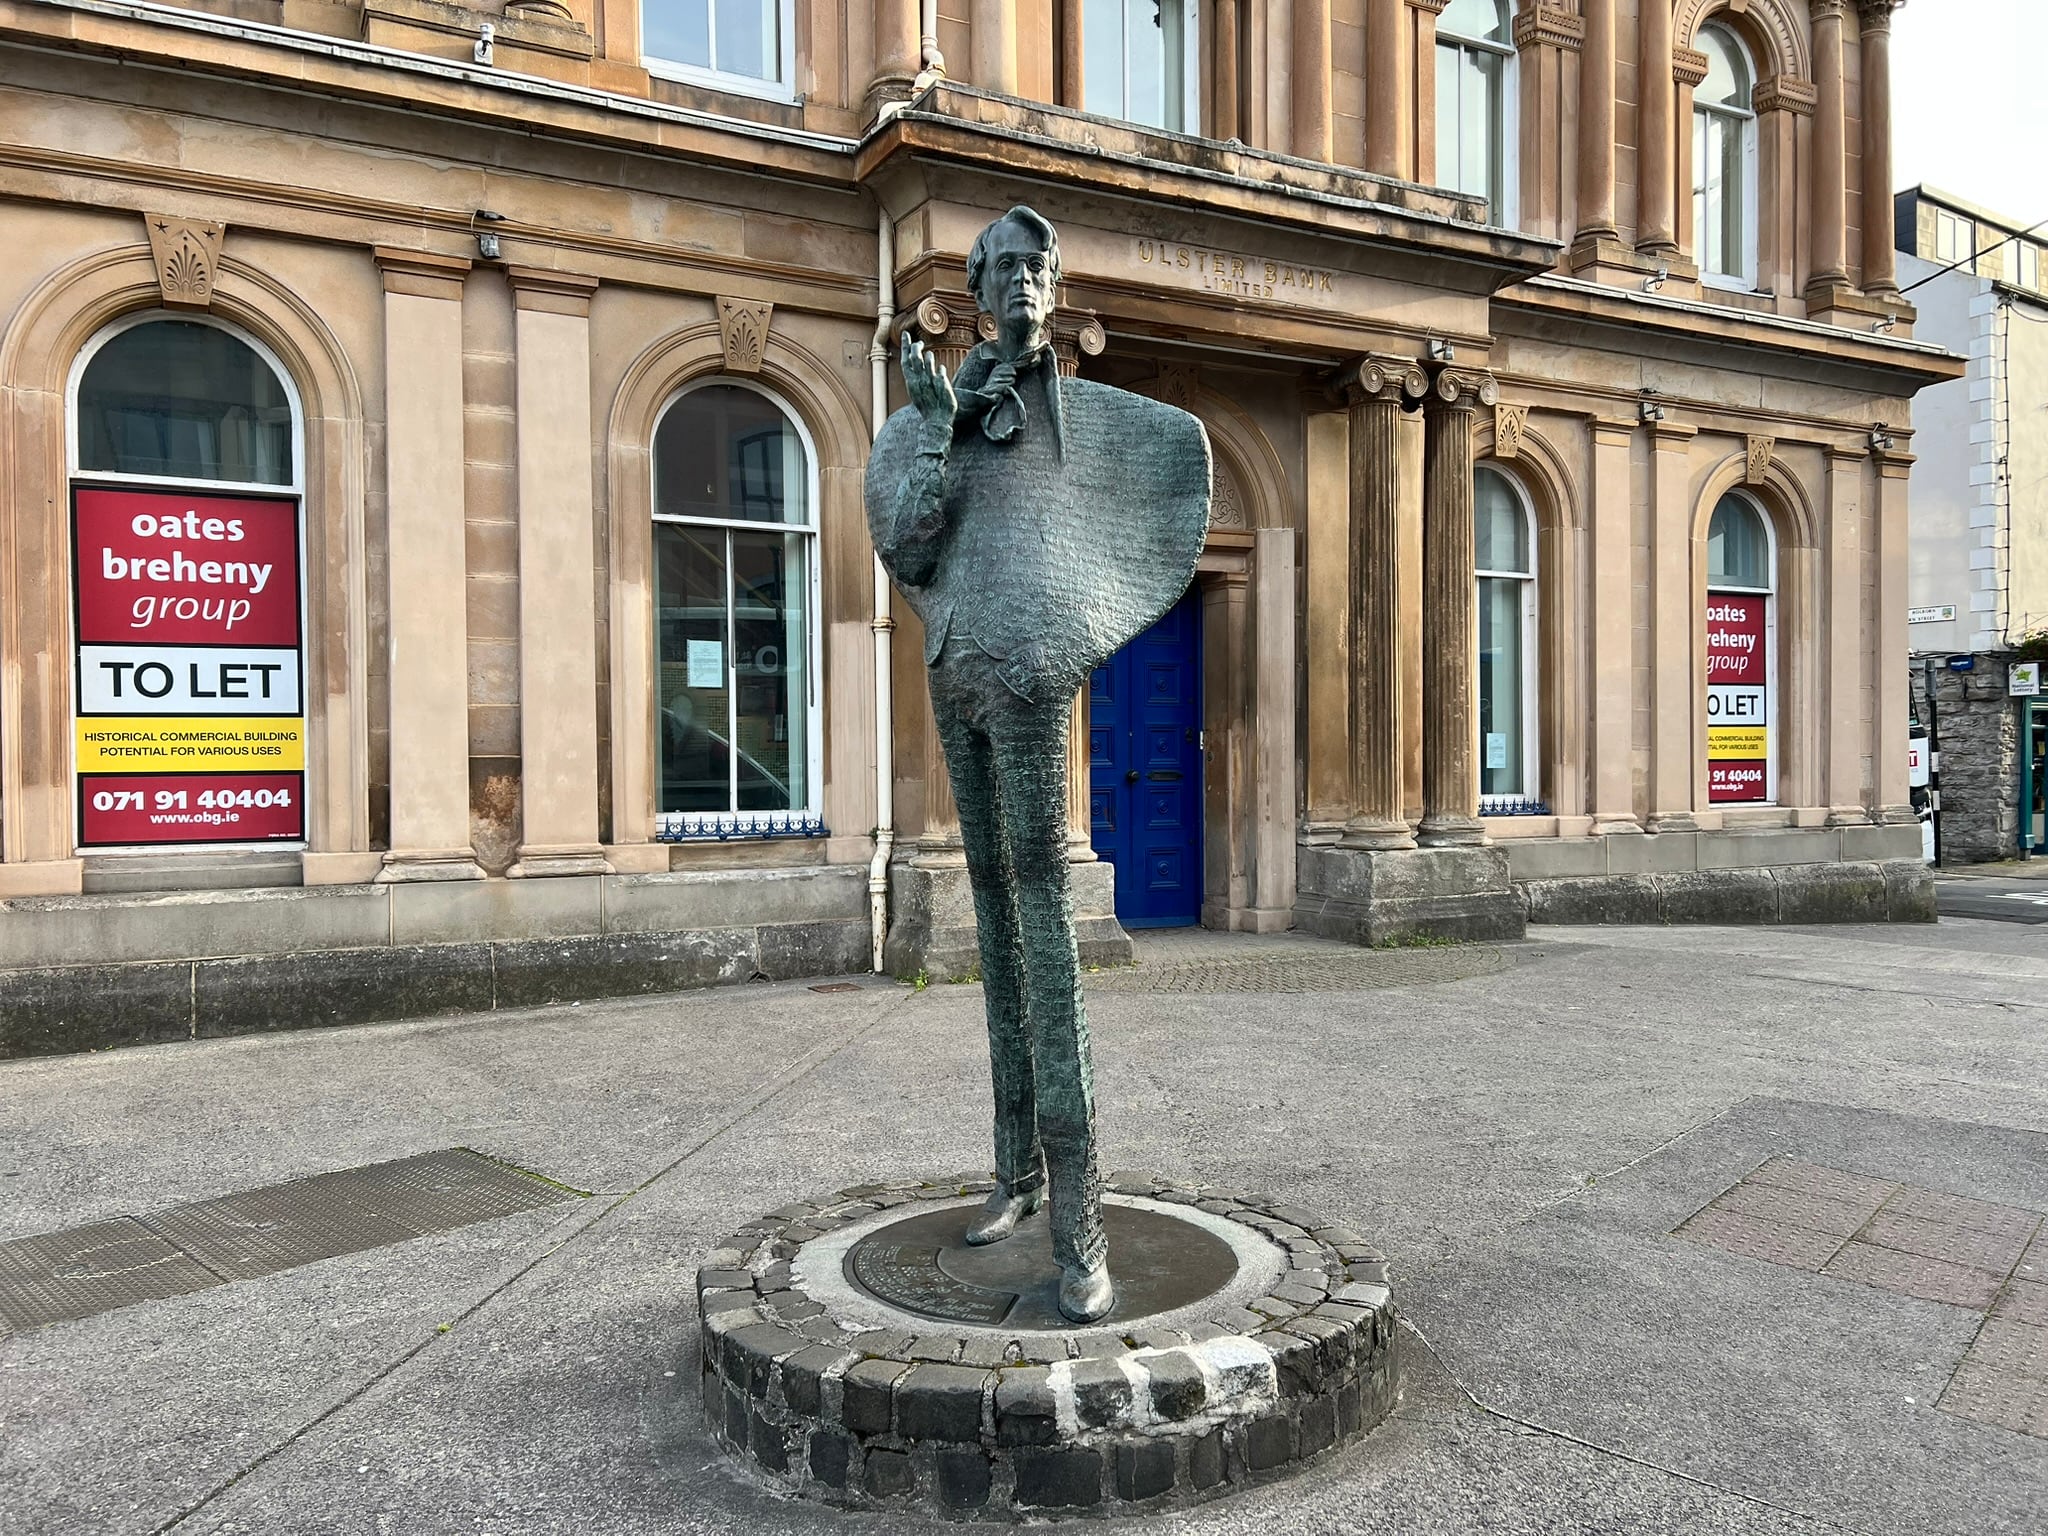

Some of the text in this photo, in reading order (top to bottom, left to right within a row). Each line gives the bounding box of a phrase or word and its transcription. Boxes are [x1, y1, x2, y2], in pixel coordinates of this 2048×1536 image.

[1138, 240, 1333, 293] ULSTER BANK
[1204, 275, 1273, 298] LIMITED
[131, 510, 245, 542] oates
[102, 547, 272, 594] breheny
[130, 595, 250, 630] group
[1707, 604, 1746, 622] oates
[1707, 628, 1756, 654] reheny
[1707, 655, 1748, 675] group
[100, 662, 282, 698] TO LET
[1708, 694, 1758, 716] O LET
[84, 732, 298, 742] HISTORICAL COMMERCIAL BUILDING
[100, 746, 282, 756] POTENTIAL FOR VARIOUS USES
[1713, 770, 1726, 782] 91
[1728, 770, 1762, 781] 40404
[92, 788, 291, 812] 071 91 40404
[150, 812, 240, 825] www.obg.ie
